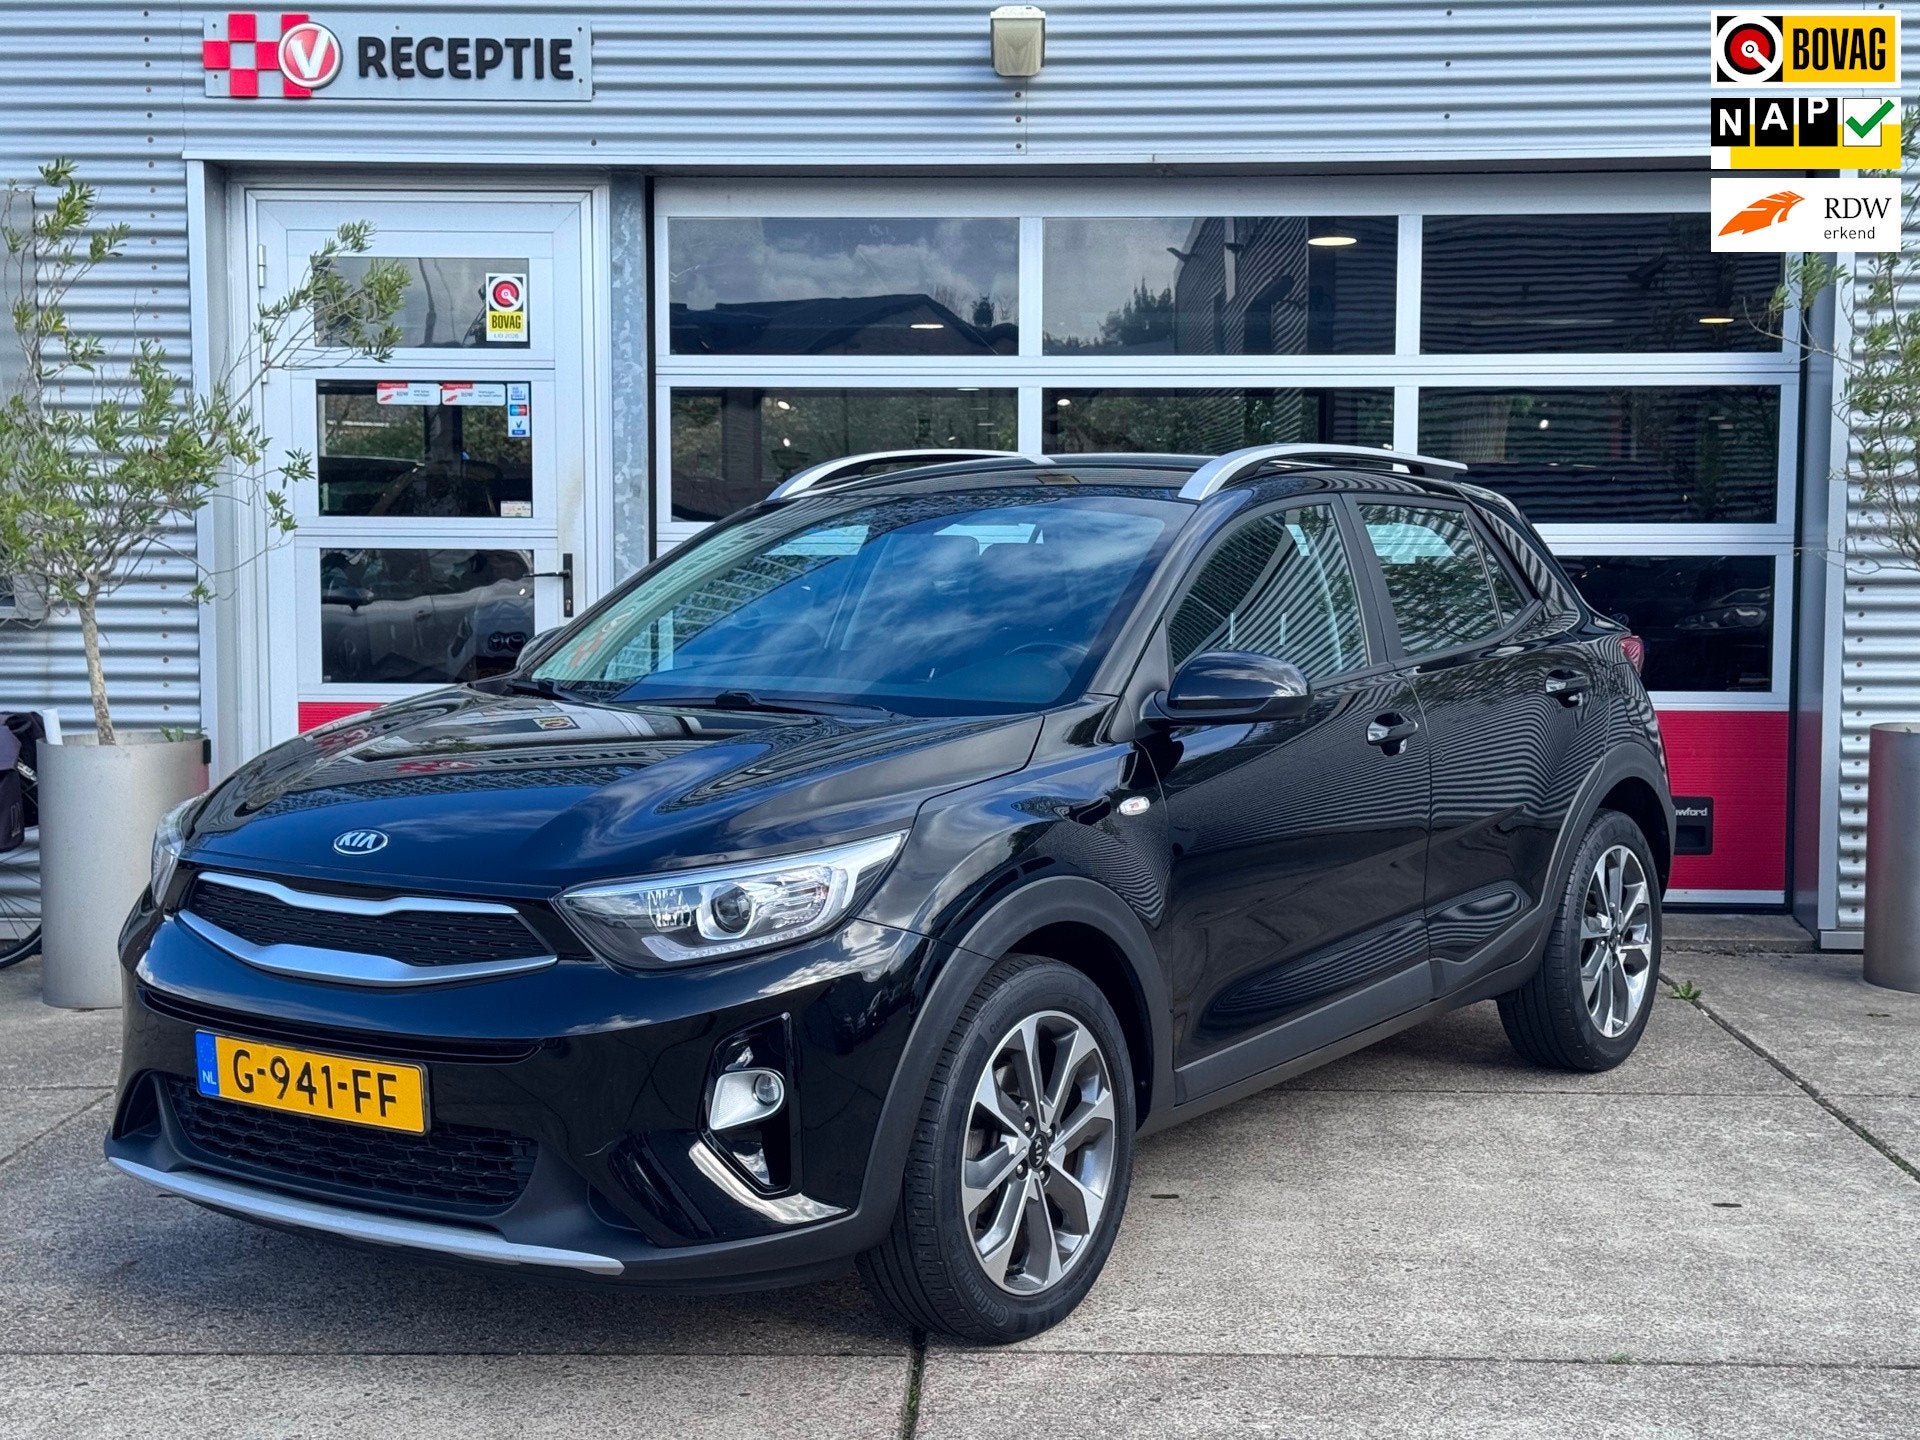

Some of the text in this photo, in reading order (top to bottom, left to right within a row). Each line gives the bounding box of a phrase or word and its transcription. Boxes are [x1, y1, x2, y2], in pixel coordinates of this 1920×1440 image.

[357, 36, 574, 80] RECEPTIE
[491, 314, 521, 329] BOVAG
[1675, 807, 1708, 817] wford
[337, 832, 378, 849] KIA
[202, 1070, 217, 1086] NL
[232, 1049, 397, 1118] G-941-FF
